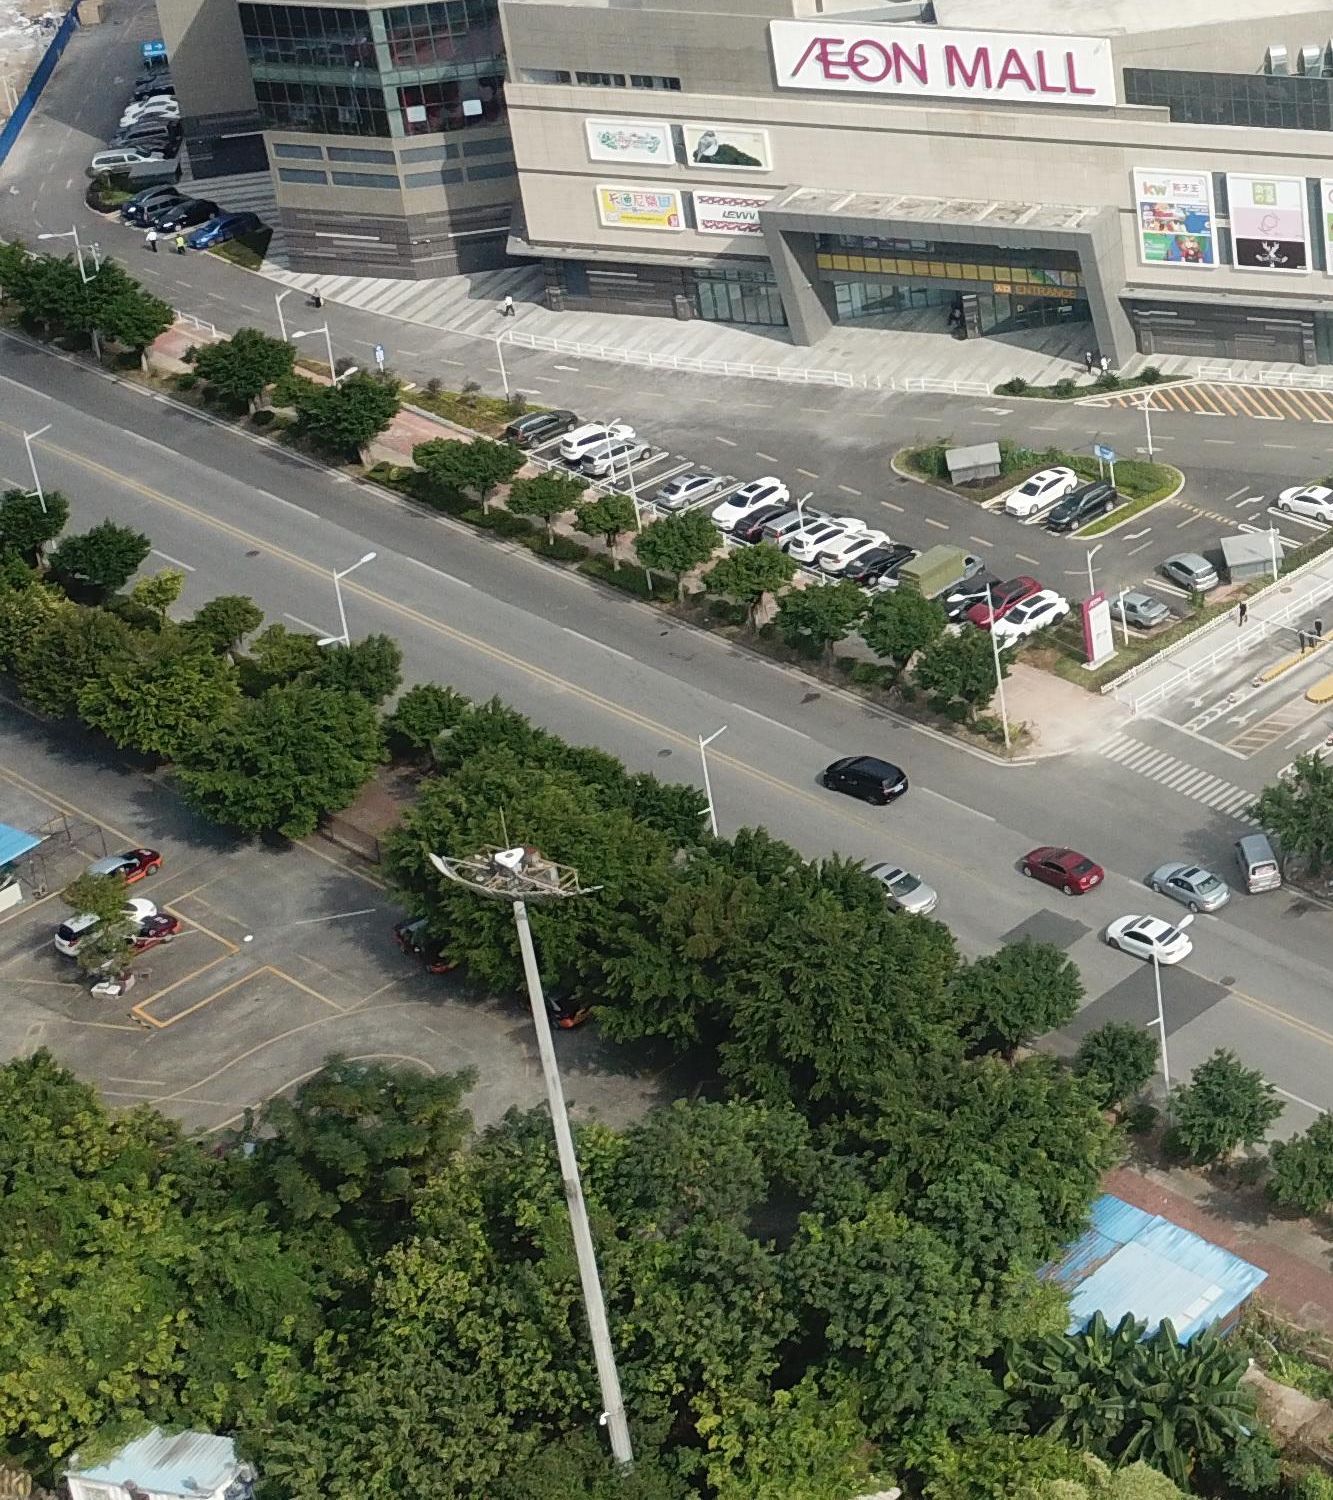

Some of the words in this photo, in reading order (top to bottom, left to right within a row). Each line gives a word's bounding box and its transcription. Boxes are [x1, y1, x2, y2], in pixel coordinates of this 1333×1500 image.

[790, 36, 929, 85] AEON
[944, 45, 1096, 95] MALL
[1015, 285, 1077, 299] ENTRANCE
